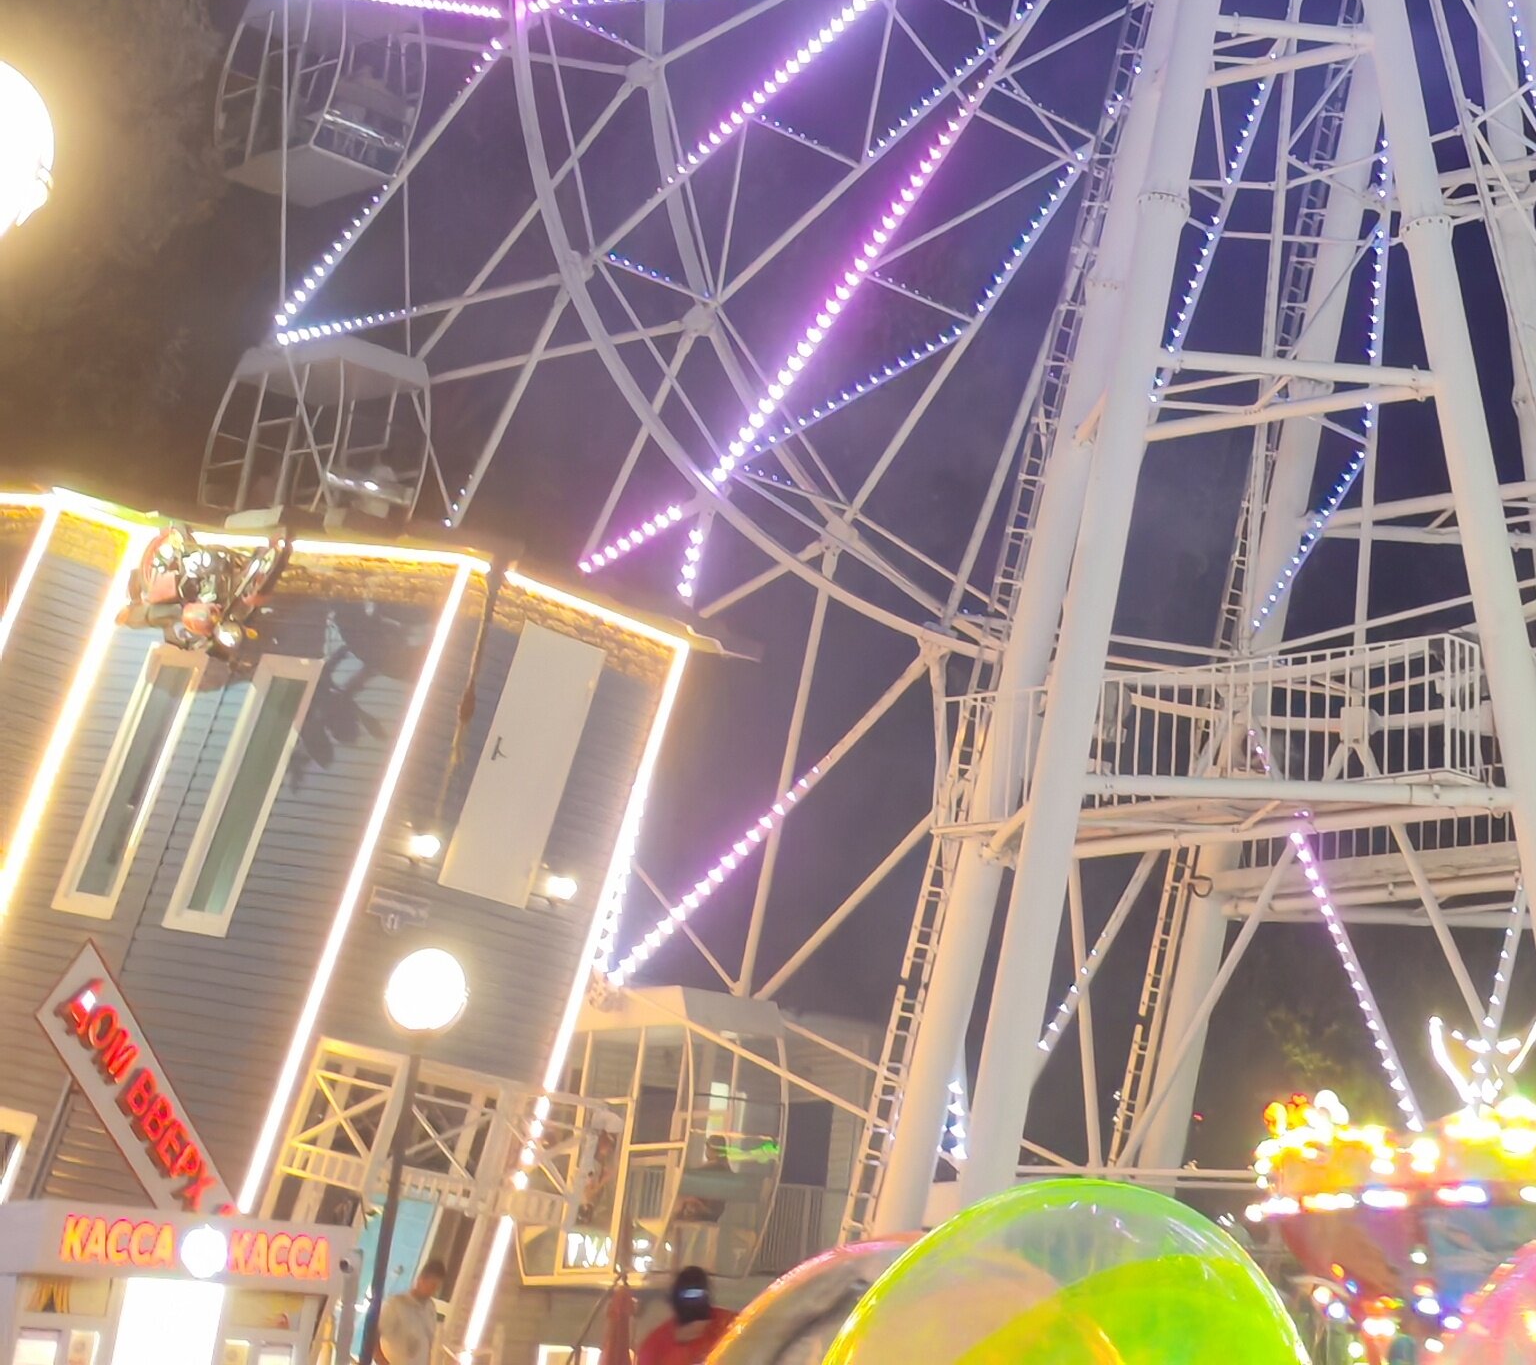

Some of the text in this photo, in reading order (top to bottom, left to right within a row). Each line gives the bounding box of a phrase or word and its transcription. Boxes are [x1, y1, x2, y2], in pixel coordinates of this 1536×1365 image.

[125, 1067, 217, 1211] ВВЕРХ
[59, 1212, 331, 1281] КАССА КАССА
